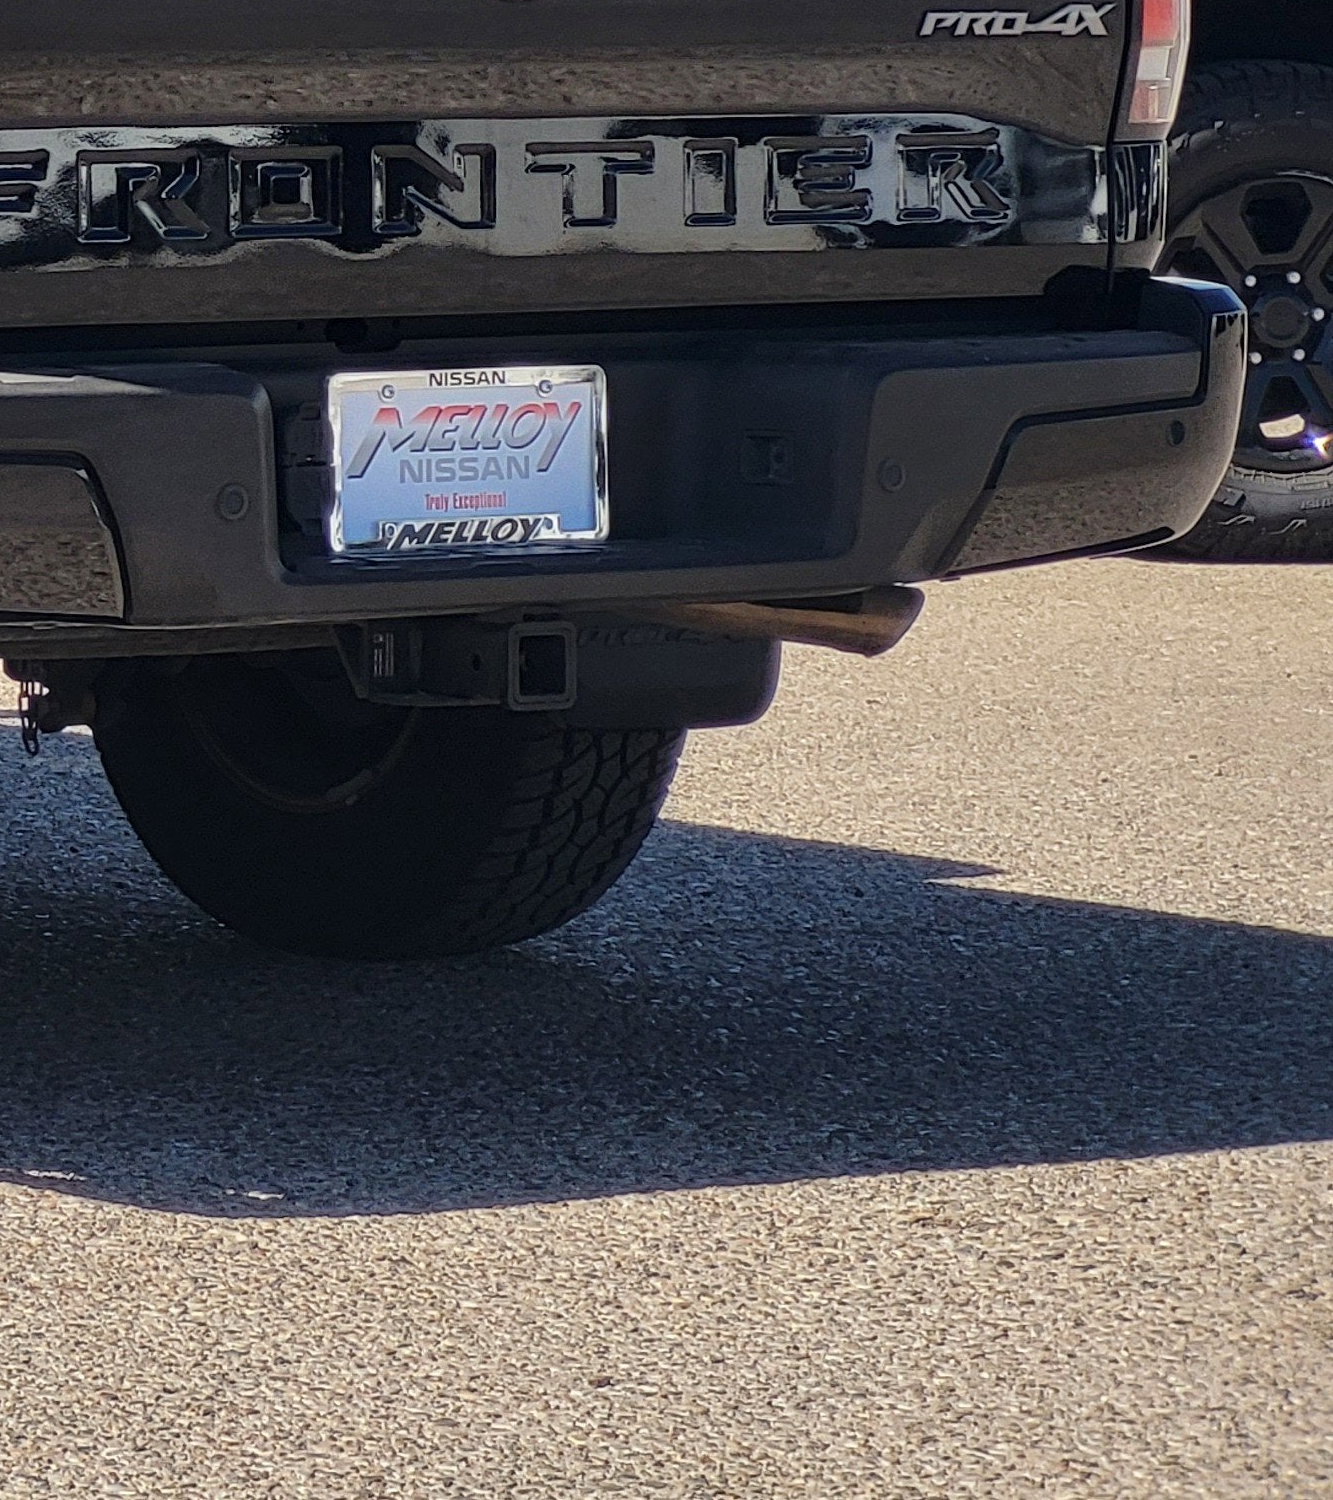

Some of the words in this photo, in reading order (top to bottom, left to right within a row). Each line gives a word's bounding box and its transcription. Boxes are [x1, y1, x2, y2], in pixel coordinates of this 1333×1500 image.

[919, 3, 1116, 37] PRO-4X
[429, 370, 506, 387] NISSAN
[345, 401, 582, 479] MELLOY
[399, 455, 530, 484] NISSAN
[425, 494, 449, 512] Truly
[453, 491, 507, 510] Exceptional
[389, 517, 543, 549] MELLOY
